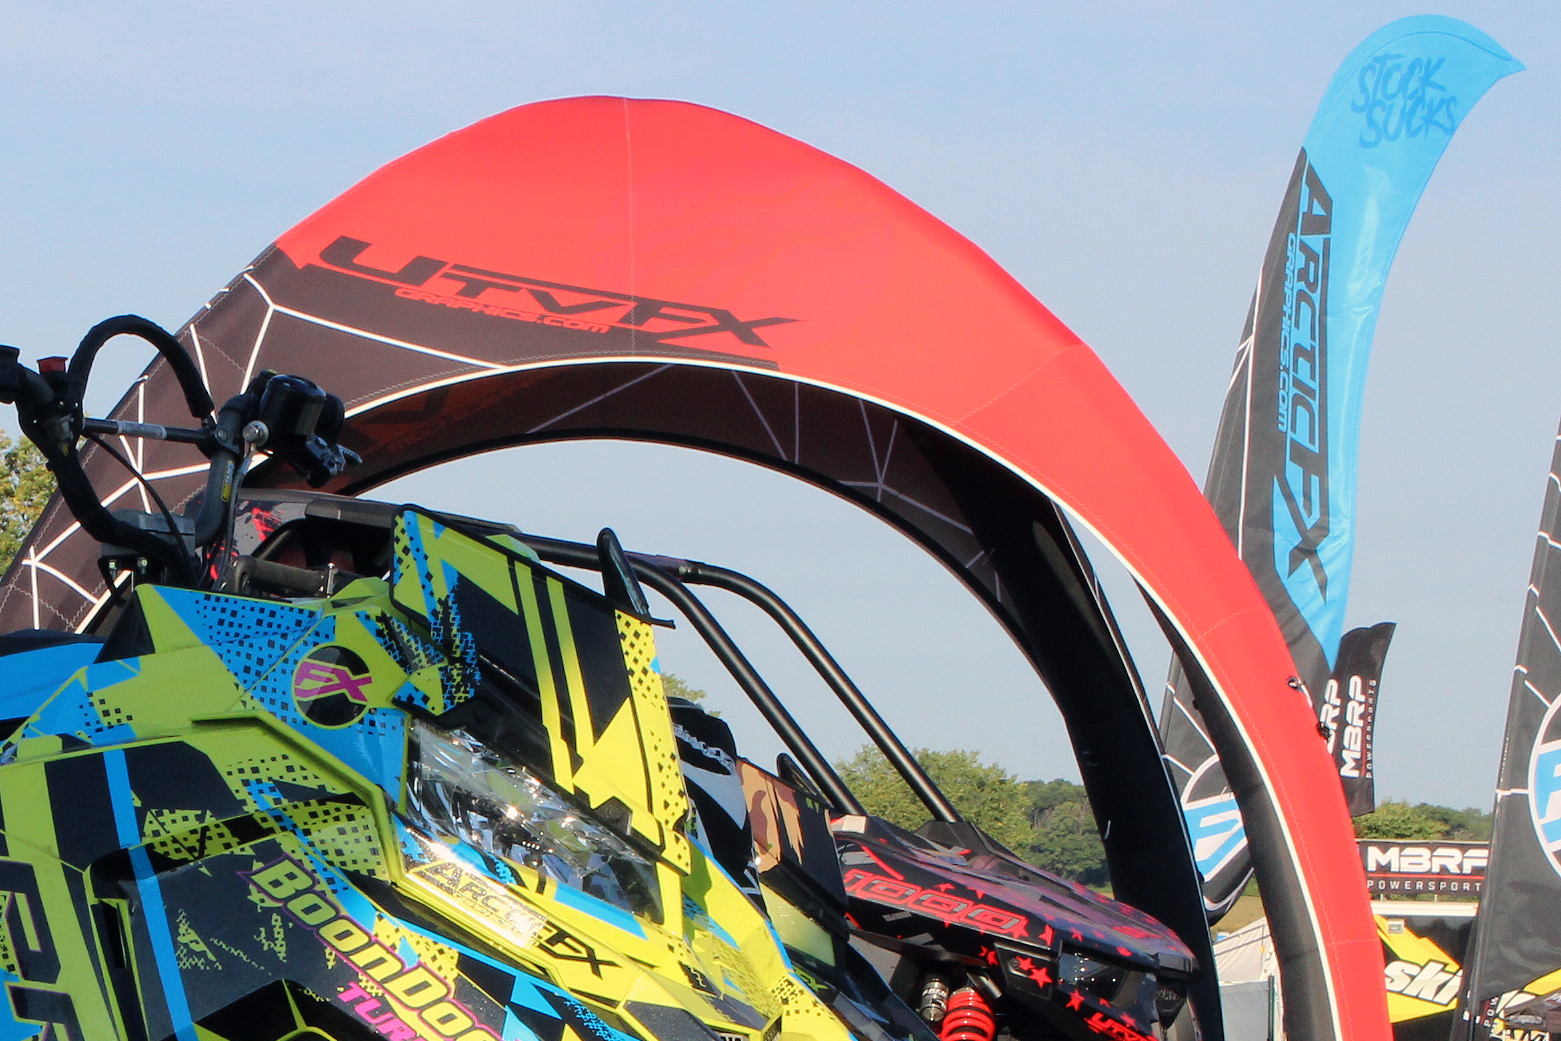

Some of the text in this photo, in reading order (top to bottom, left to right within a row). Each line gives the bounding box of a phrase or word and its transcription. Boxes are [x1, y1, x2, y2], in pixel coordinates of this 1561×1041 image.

[1351, 53, 1447, 114] STOCK
[1359, 95, 1458, 149] SUCKS
[294, 661, 373, 702] FX
[1340, 675, 1367, 779] MBRP
